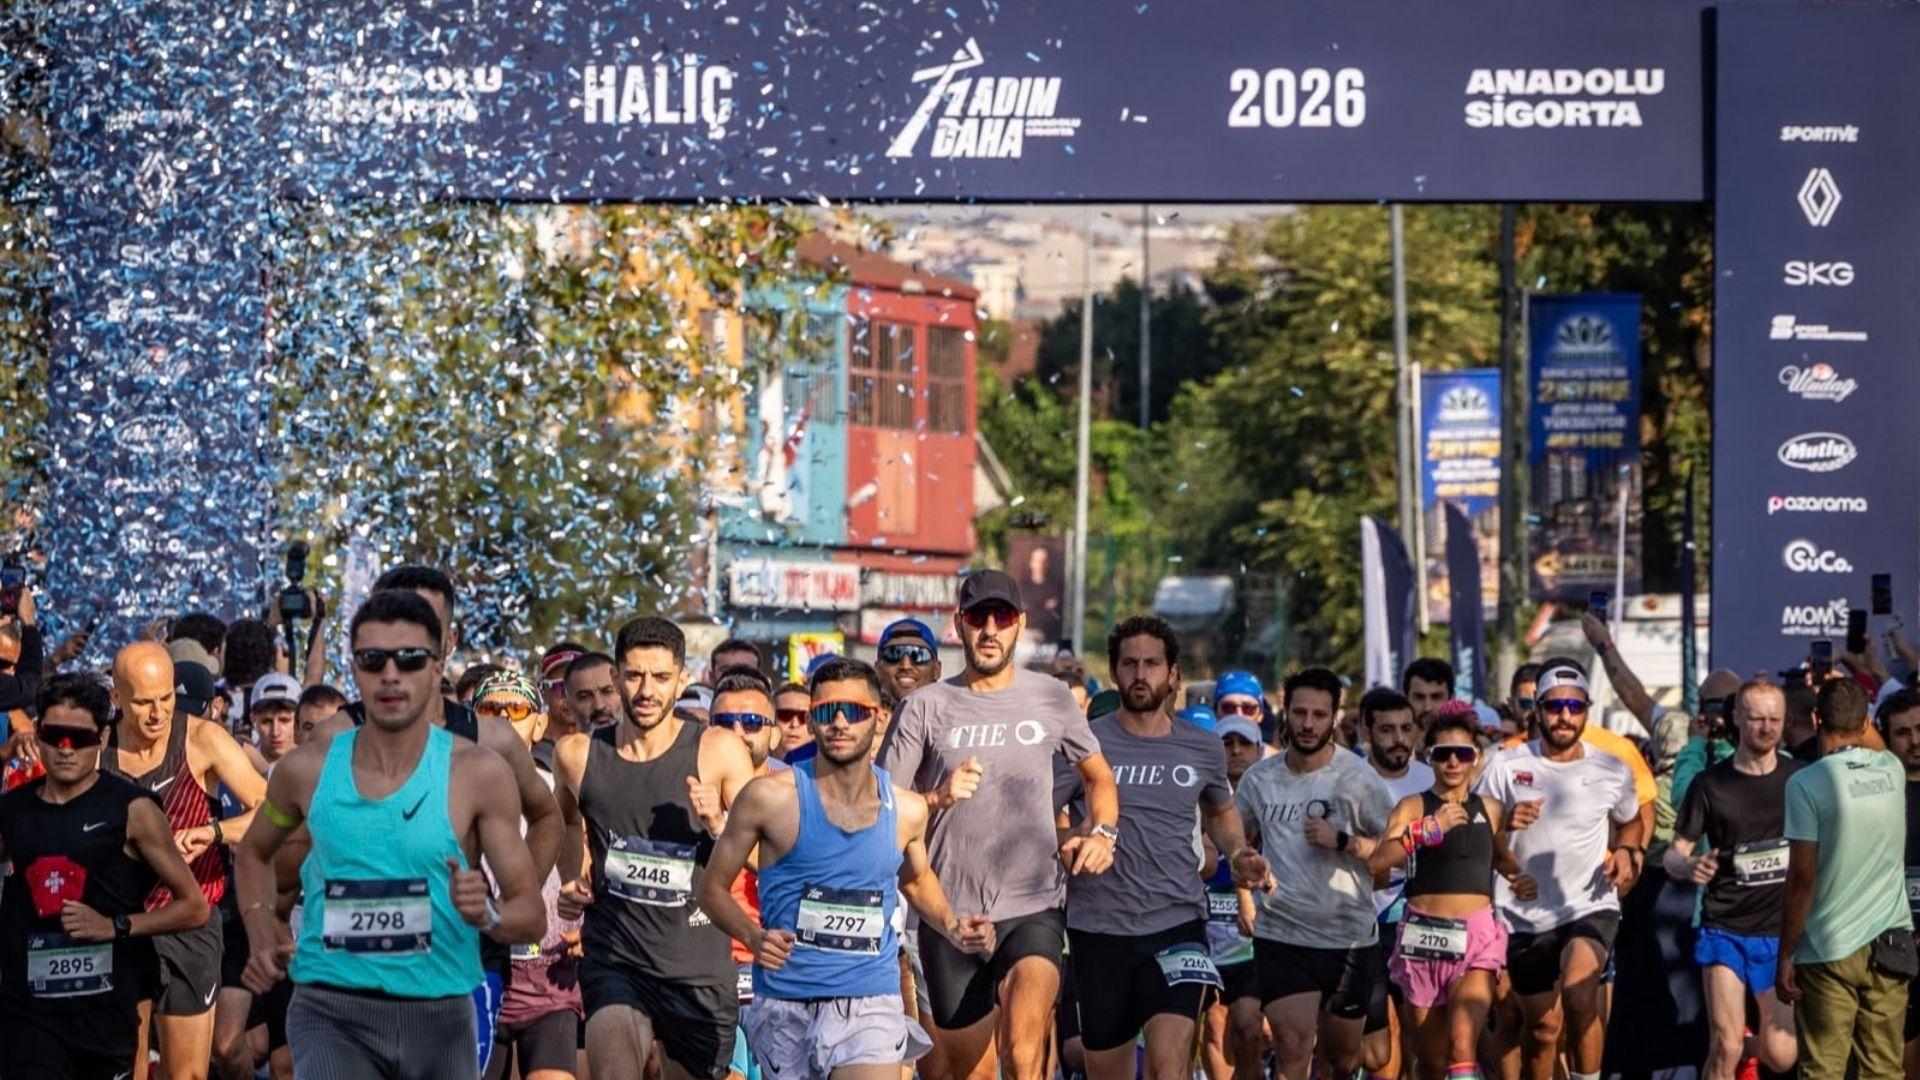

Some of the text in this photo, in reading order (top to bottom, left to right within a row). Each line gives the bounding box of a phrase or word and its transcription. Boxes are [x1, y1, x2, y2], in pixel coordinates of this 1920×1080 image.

[307, 66, 502, 92] NADOLU
[1465, 68, 1665, 95] ANADOLU
[584, 53, 733, 140] HALİÇ
[967, 77, 1062, 117] ADIM
[1228, 67, 1366, 127] 2026
[1464, 94, 1643, 127] SİGORTA
[930, 117, 1025, 158] DAHA
[1783, 261, 1855, 286] SKG
[1786, 439, 1847, 460] Mutlu
[1767, 496, 1867, 515] pazarama
[948, 724, 1007, 749] THE
[1113, 765, 1165, 785] THE
[1260, 804, 1302, 822] THE
[627, 864, 670, 884] 2448
[1751, 857, 1780, 870] 2924
[351, 911, 405, 931] 2798
[824, 915, 866, 932] 2797
[1420, 933, 1449, 948] 2170
[49, 957, 94, 975] 2895
